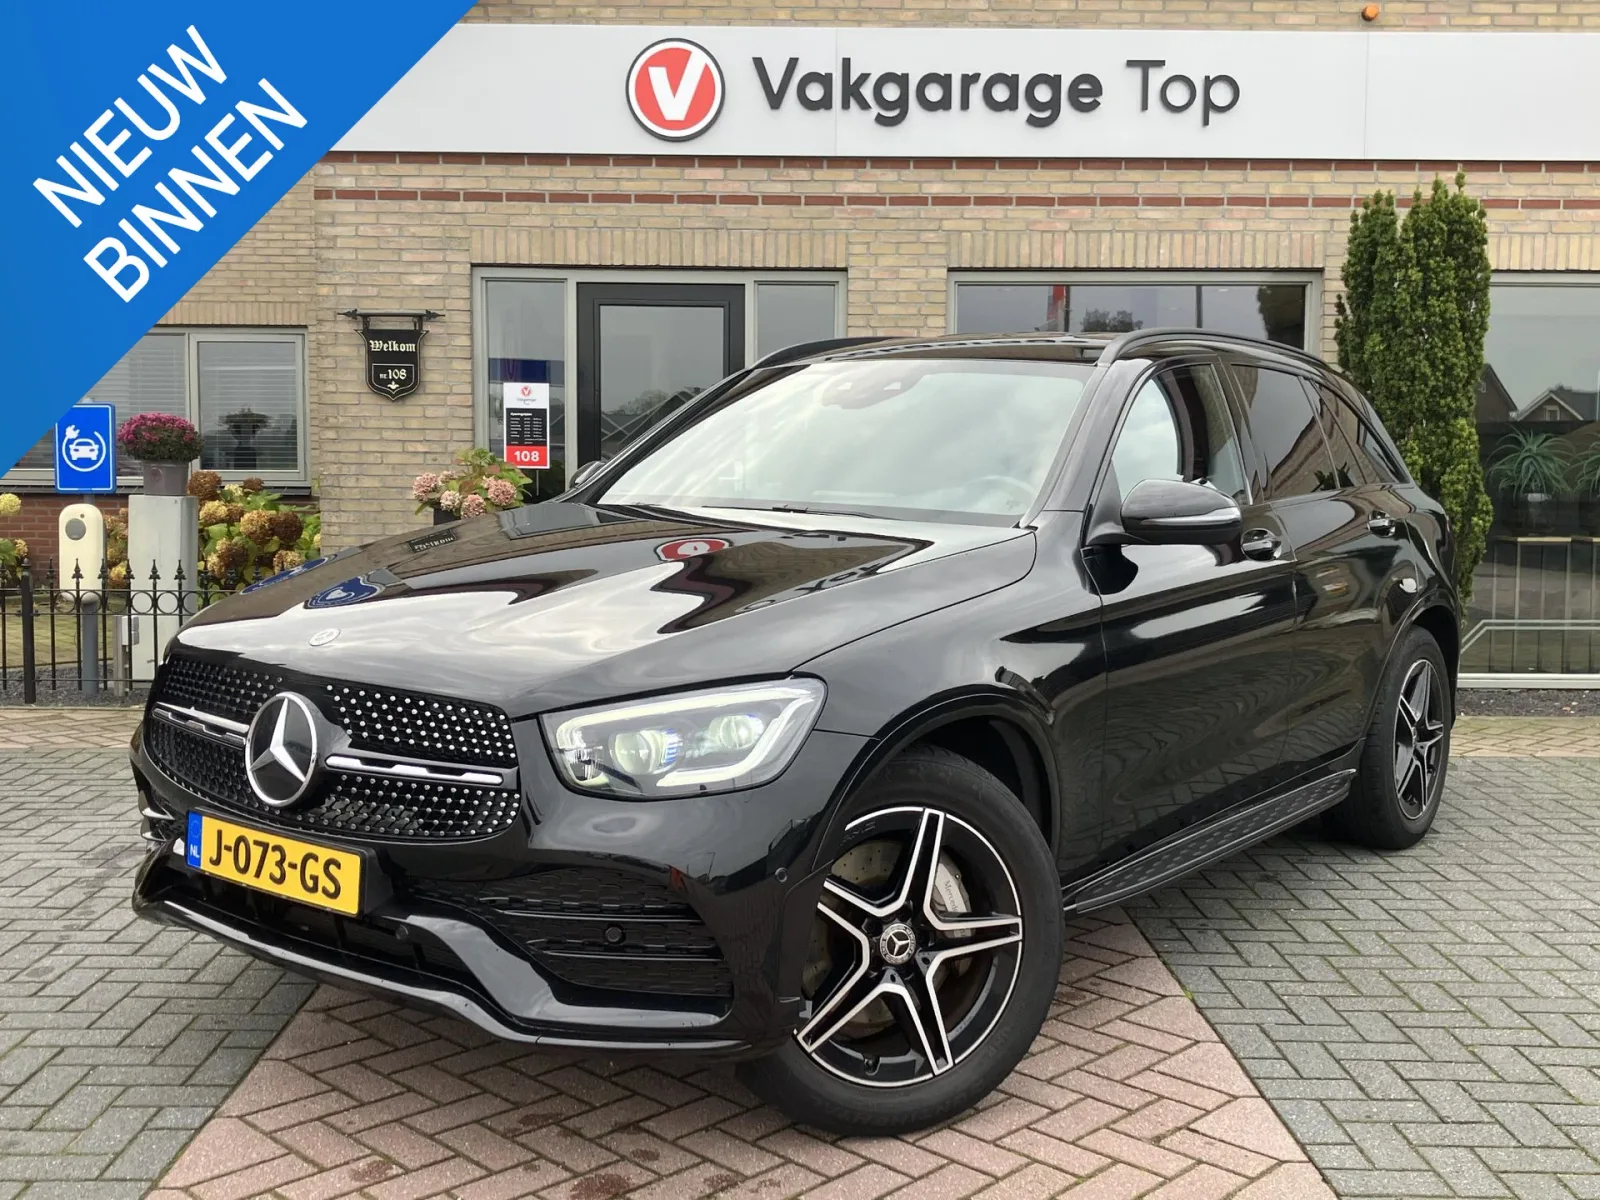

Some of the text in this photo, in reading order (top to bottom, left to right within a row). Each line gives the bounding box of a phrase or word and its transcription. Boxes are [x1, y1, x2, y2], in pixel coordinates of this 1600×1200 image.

[752, 56, 1240, 129] Vakgarage Top
[369, 339, 416, 352] Welkom
[513, 450, 540, 462] 108
[190, 843, 200, 859] NL
[208, 828, 342, 900] J-073-GS
